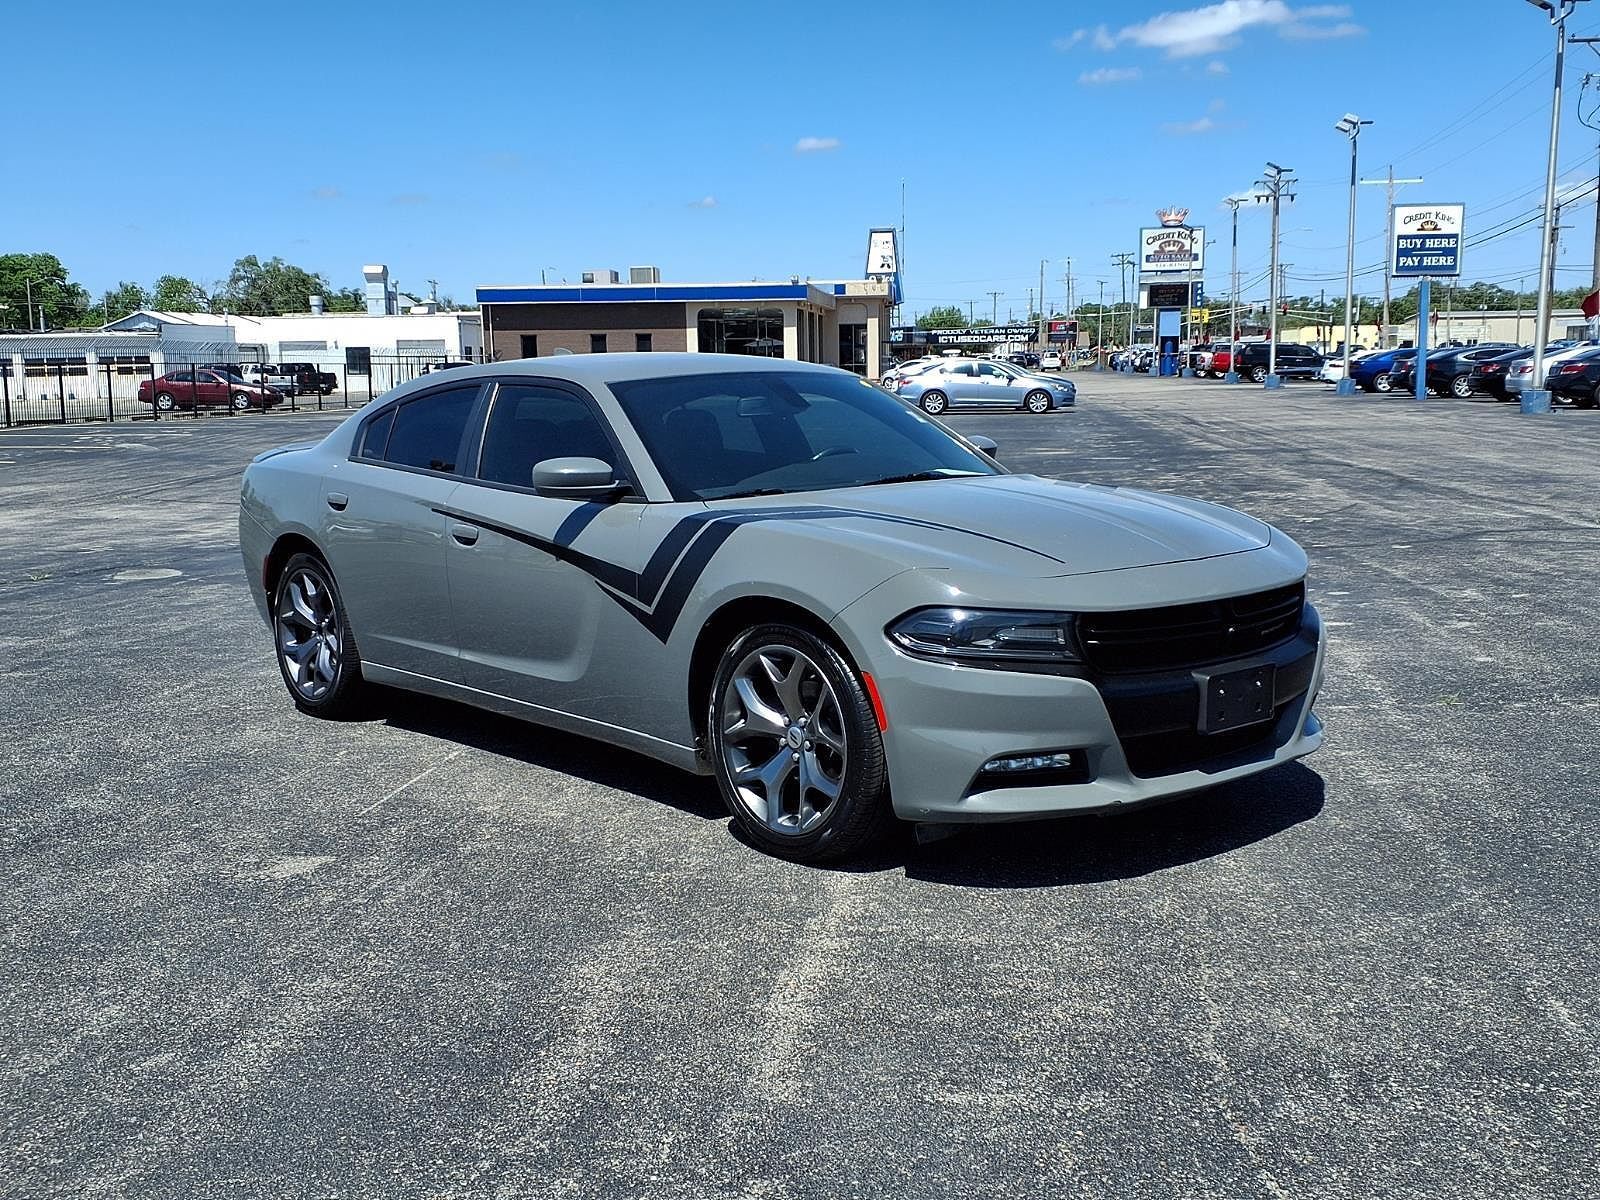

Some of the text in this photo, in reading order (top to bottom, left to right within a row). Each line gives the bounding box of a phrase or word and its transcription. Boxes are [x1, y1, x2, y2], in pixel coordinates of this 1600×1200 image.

[1404, 211, 1455, 224] CREDIT KING
[1146, 232, 1176, 245] CREDIT
[1399, 238, 1456, 248] BUY HERE
[1399, 256, 1455, 266] PAY HERE
[938, 334, 1029, 343] ICTUSEDCARS.COM
